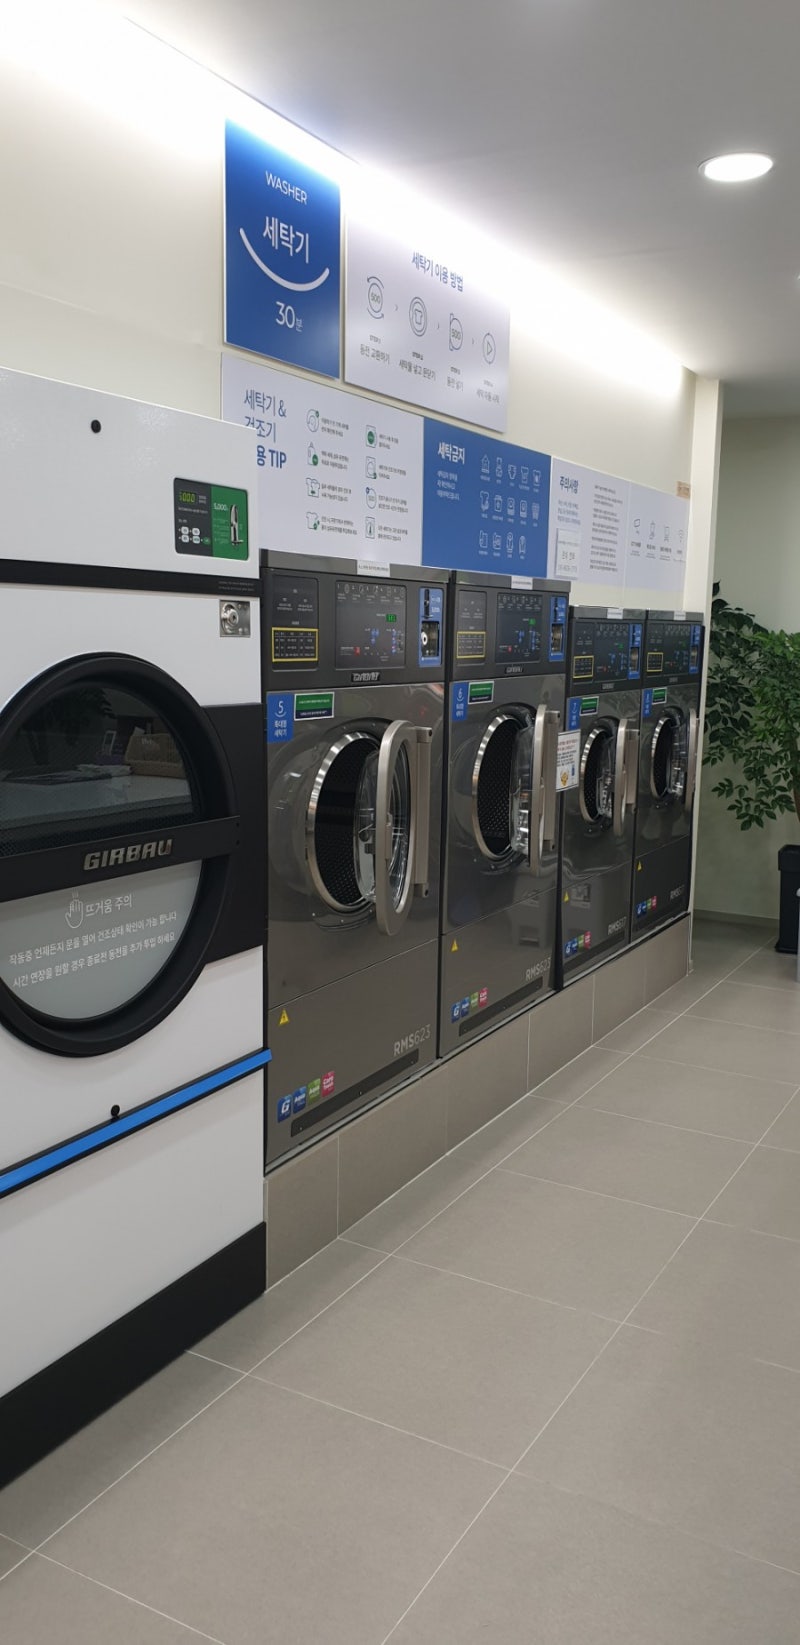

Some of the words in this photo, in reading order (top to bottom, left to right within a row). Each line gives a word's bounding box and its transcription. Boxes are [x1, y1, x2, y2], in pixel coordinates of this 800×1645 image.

[265, 170, 307, 205] WASHER
[263, 216, 309, 264] 세탁기
[411, 250, 433, 277] 세탁기
[434, 263, 448, 284] 이용
[450, 271, 463, 292] 방법
[371, 293, 380, 304] 500
[244, 389, 276, 417] 세탁기
[278, 399, 287, 418] &
[268, 448, 287, 469] TIP
[438, 441, 465, 465] 세탁금지
[559, 475, 578, 494] 주의사항
[278, 700, 284, 714] 5
[83, 839, 173, 871] GIRBAU
[85, 898, 113, 917] 뜨거움
[114, 893, 132, 911] 주의
[9, 949, 33, 965] 작동중
[66, 936, 80, 951] 문을
[81, 933, 96, 947] 열어
[98, 925, 124, 942] 건조상태
[125, 920, 145, 933] 확인이
[145, 916, 158, 928] 가능
[159, 911, 177, 925] 합니다
[12, 973, 29, 988] 시간
[30, 967, 53, 984] 연장을
[54, 962, 69, 977] 원할
[71, 957, 86, 972] 경우
[87, 951, 107, 967] 종료전
[108, 944, 128, 961] 동전을
[129, 941, 142, 953] 추가
[143, 937, 157, 949] 투입
[157, 931, 175, 945] 하세요
[393, 1023, 431, 1057] RMS623
